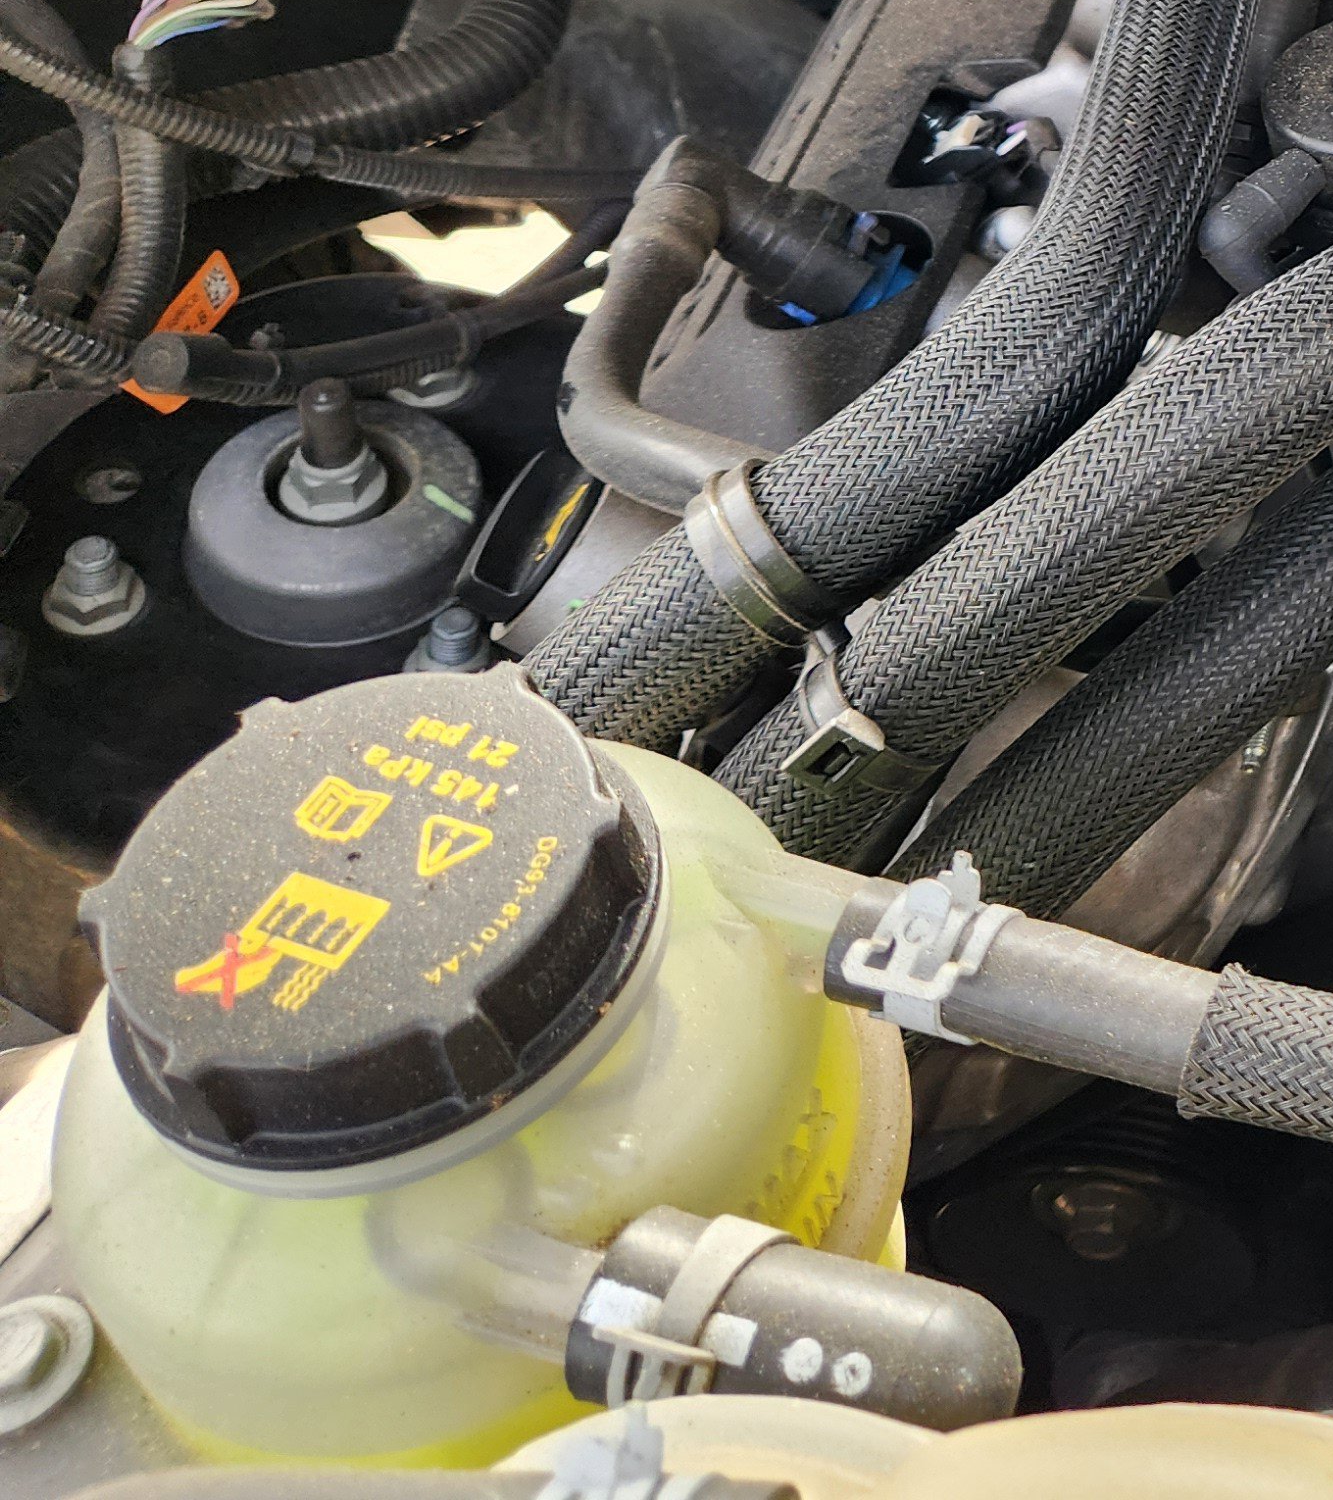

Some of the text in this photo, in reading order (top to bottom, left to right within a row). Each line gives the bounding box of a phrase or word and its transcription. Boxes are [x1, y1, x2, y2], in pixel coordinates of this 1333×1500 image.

[404, 714, 520, 768] 21 psi
[363, 743, 501, 811] 145 kPa
